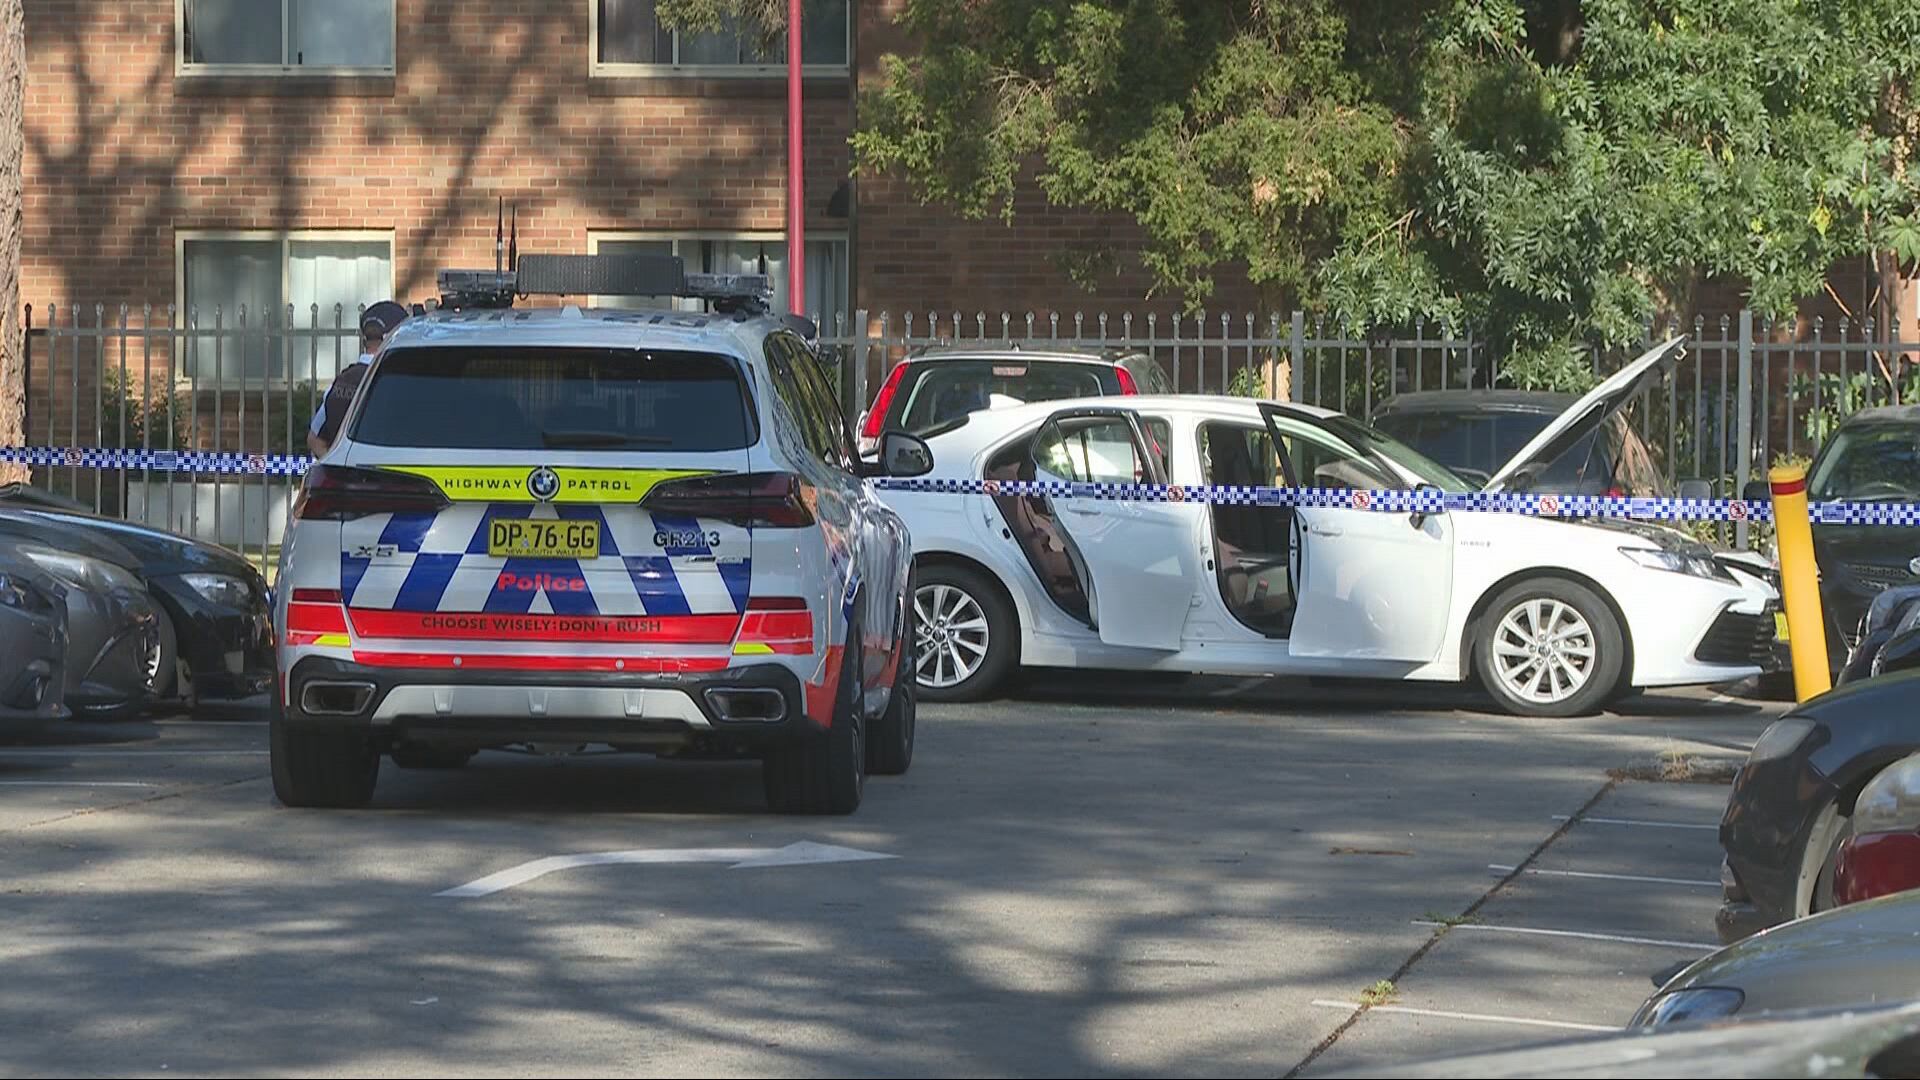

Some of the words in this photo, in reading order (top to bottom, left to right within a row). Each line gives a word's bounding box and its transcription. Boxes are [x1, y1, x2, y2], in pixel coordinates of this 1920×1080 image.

[444, 478, 523, 489] HIGHWAY
[568, 479, 632, 490] PATROL
[653, 529, 721, 548] GR213
[354, 545, 395, 558] X5
[498, 570, 586, 592] Police
[421, 616, 487, 630] CHOOSE
[617, 620, 661, 633] RUSH
